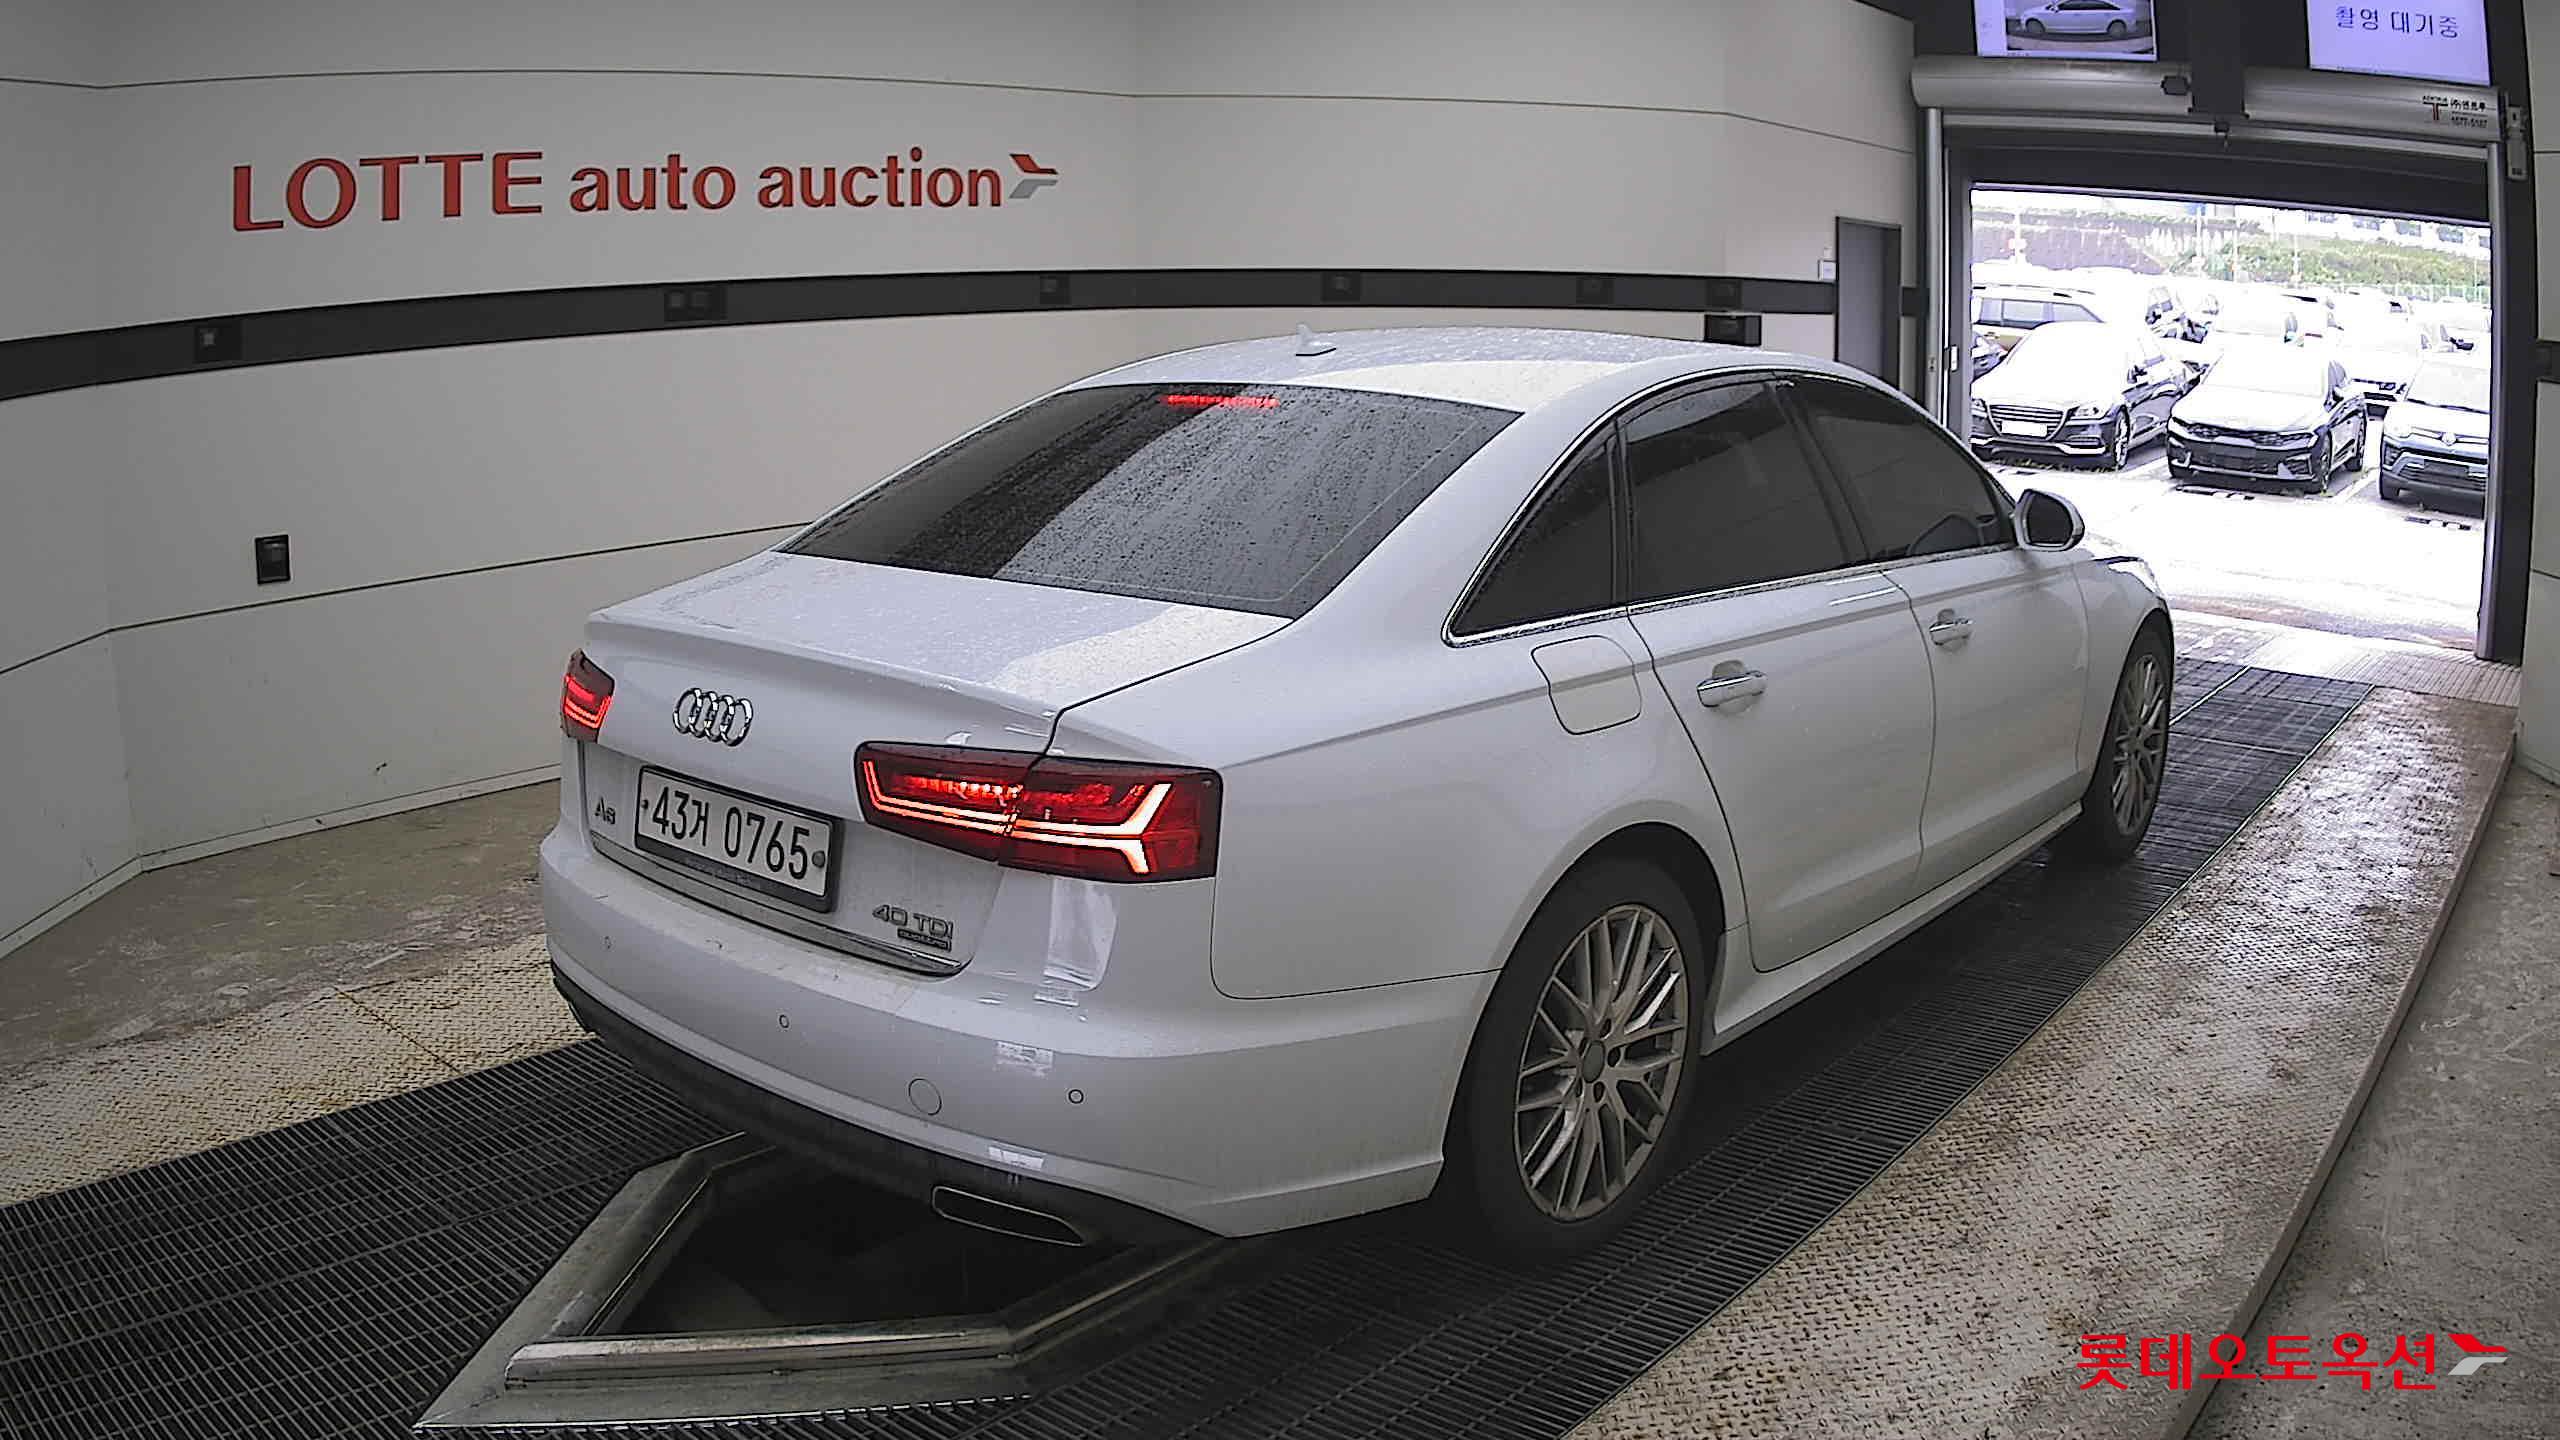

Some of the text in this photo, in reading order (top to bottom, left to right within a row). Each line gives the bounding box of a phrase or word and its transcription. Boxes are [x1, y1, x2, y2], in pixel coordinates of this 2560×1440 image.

[2335, 5, 2379, 31] 촬영
[233, 146, 1002, 232] LOTTE auto auction
[652, 785, 709, 846] 43거
[723, 805, 812, 881] 0765
[872, 904, 908, 927] 40
[912, 912, 954, 940] TDI
